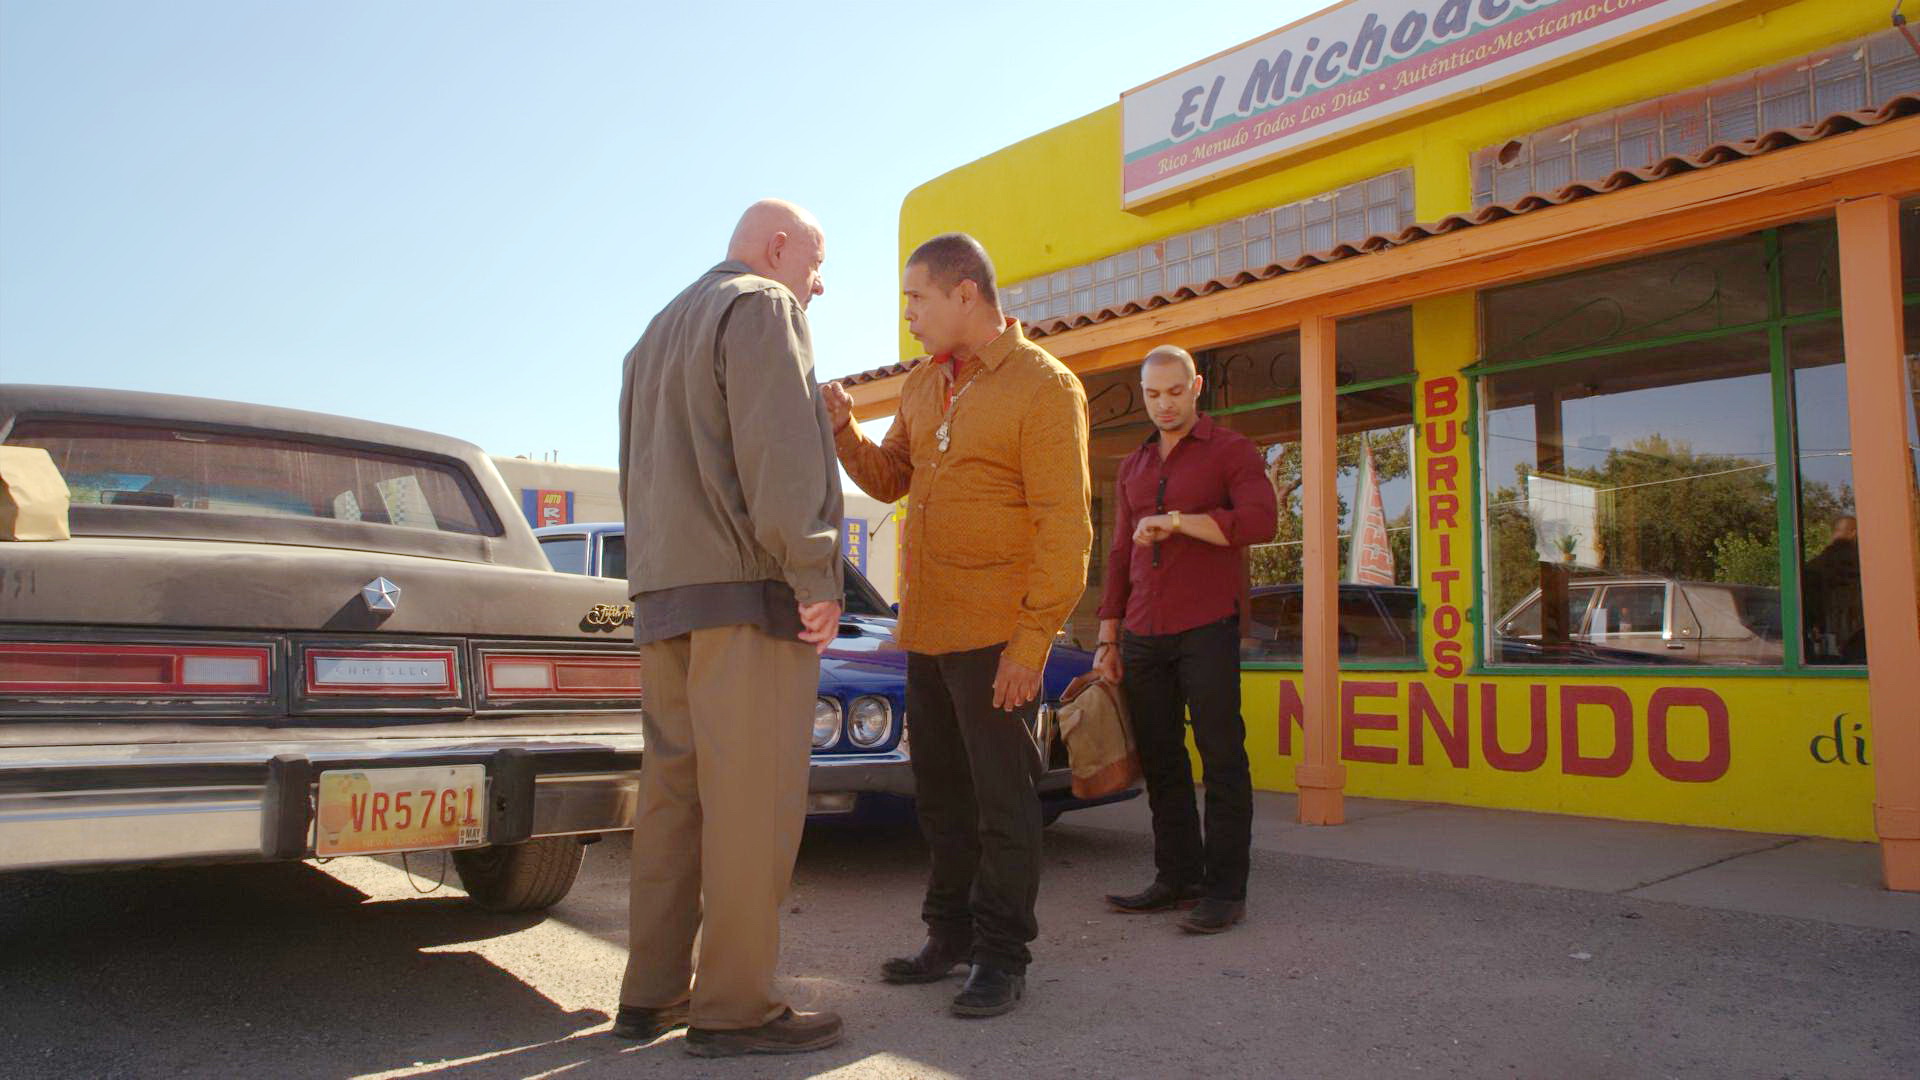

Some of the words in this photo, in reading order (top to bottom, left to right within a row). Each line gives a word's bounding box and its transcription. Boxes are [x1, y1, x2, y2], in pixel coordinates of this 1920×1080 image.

[1171, 75, 1226, 138] El
[1238, 0, 1538, 112] Michoac
[1158, 155, 1188, 175] Rico
[1191, 126, 1249, 163] Menudo
[1253, 112, 1297, 141] Todos
[1299, 101, 1327, 123] Los
[543, 494, 562, 504] AUTO
[1424, 376, 1463, 679] BURRITOS
[335, 666, 429, 677] CHRYSLER
[465, 828, 481, 839] MAY
